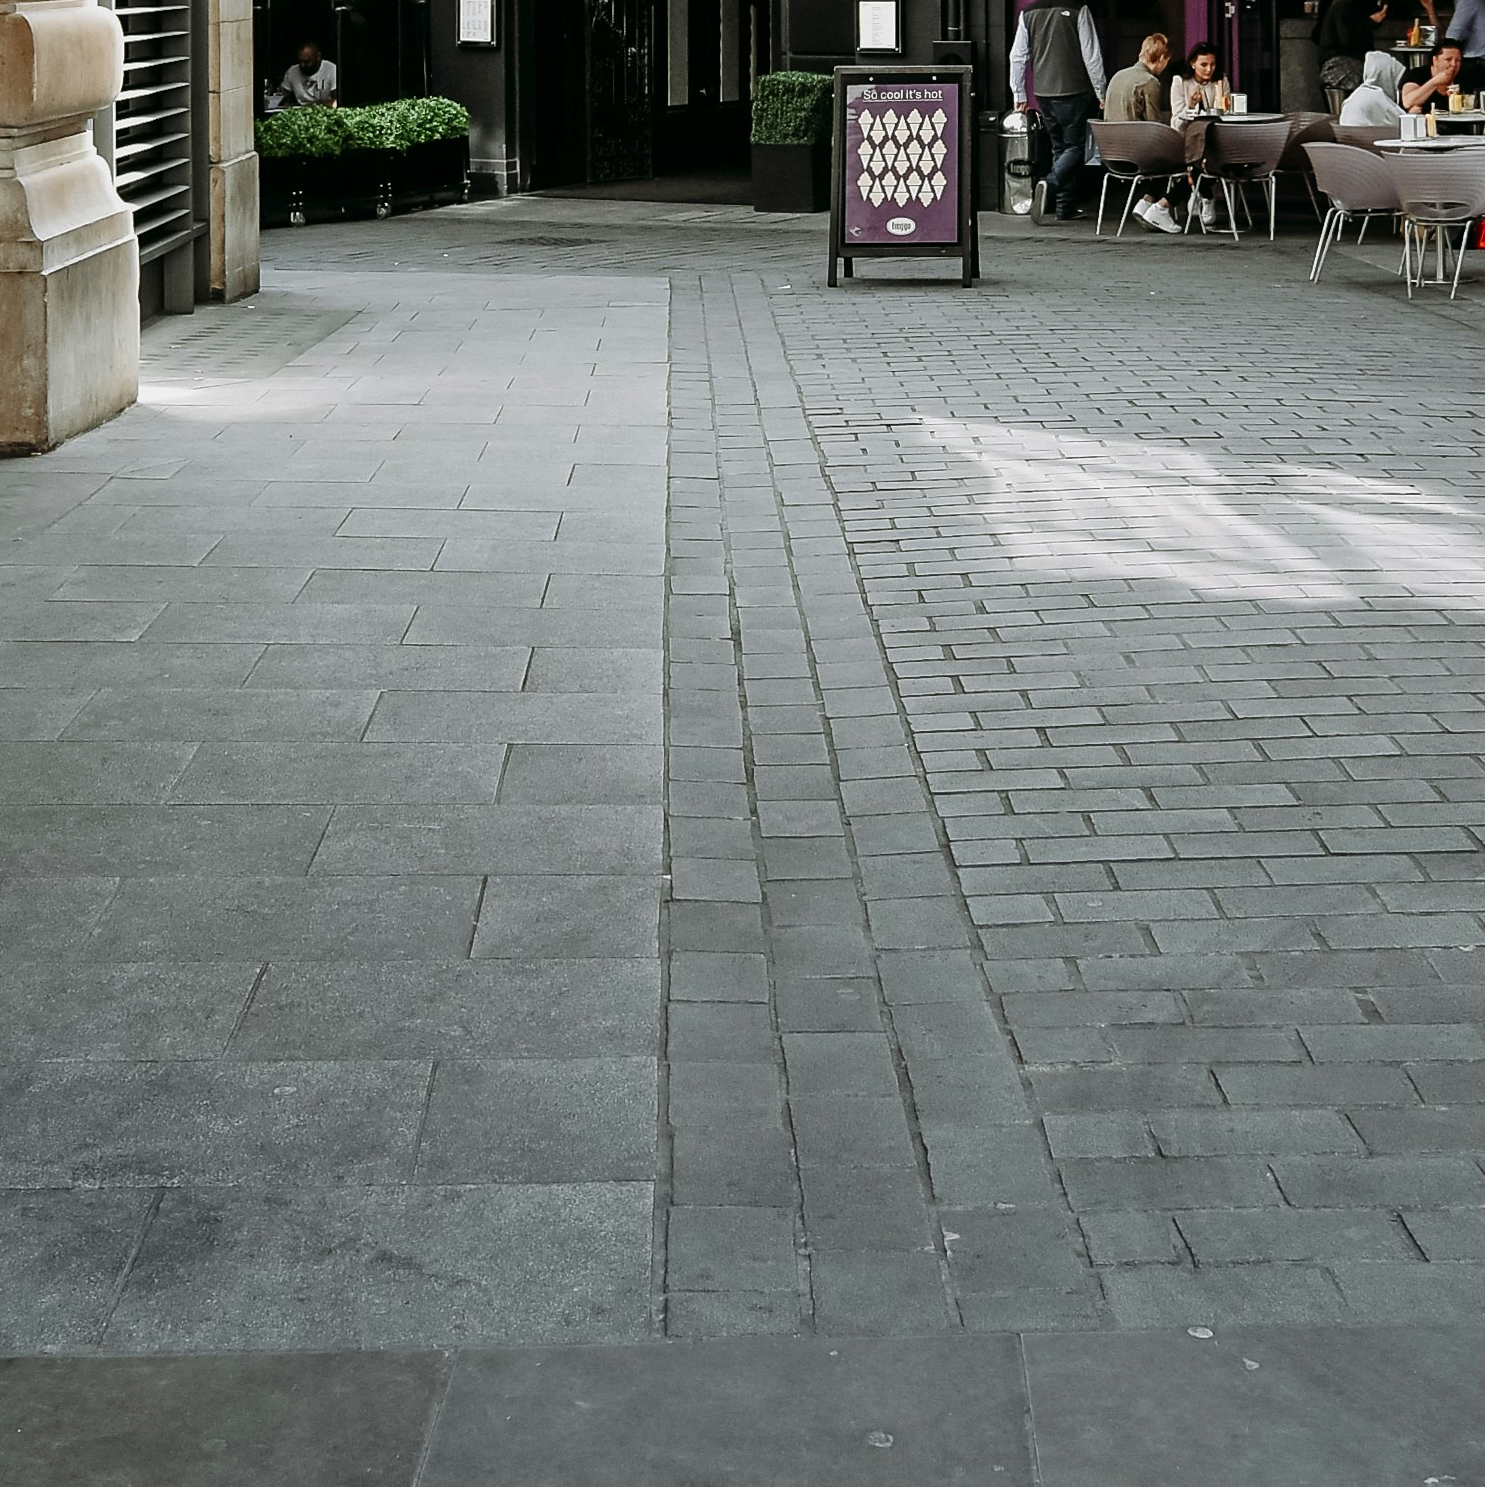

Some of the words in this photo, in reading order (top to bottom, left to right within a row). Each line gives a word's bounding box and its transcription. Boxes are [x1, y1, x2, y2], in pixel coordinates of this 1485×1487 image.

[863, 89, 878, 100] So
[880, 89, 904, 100] cool
[924, 88, 943, 99] hot
